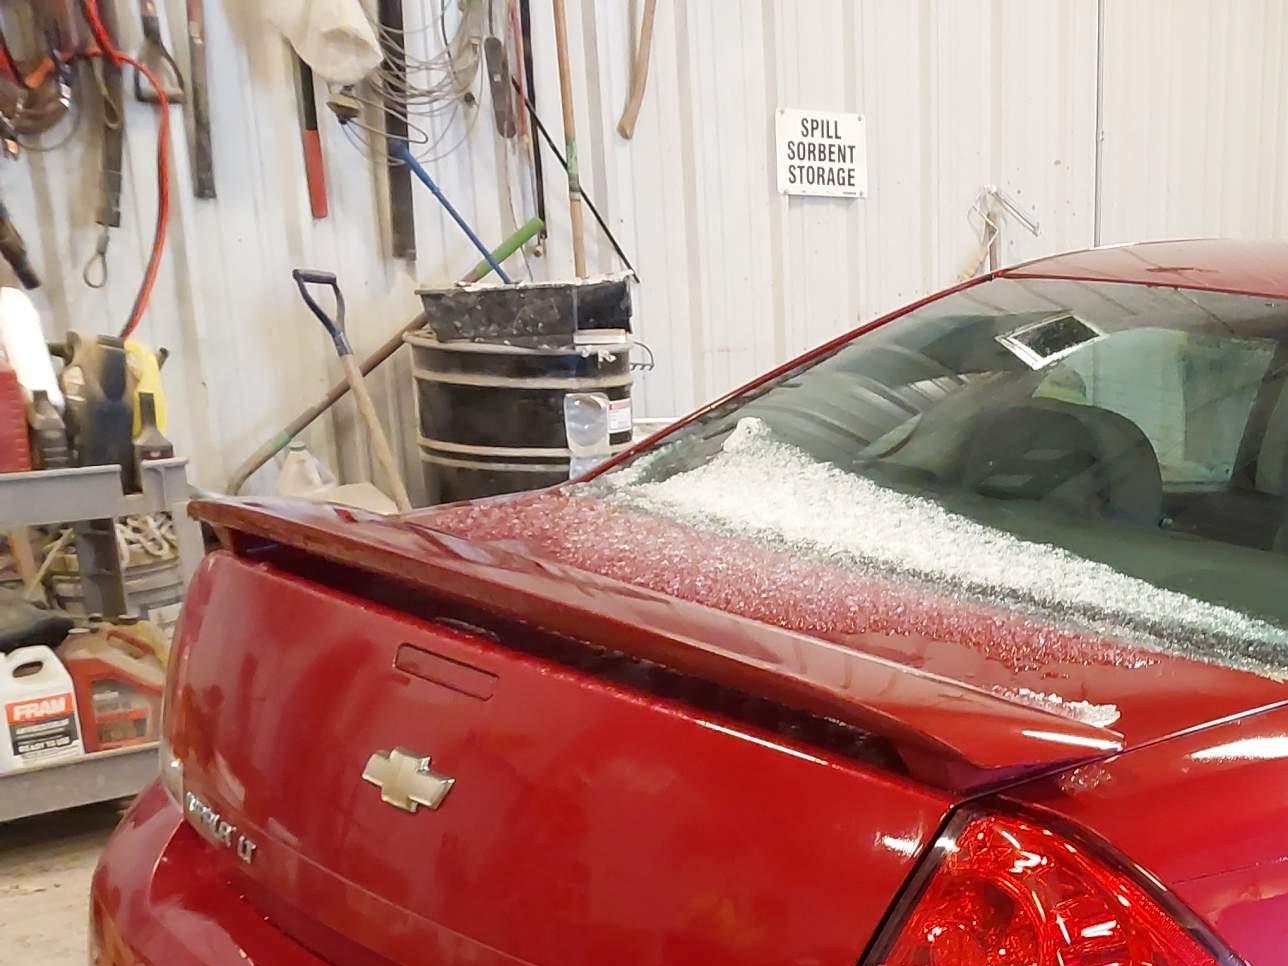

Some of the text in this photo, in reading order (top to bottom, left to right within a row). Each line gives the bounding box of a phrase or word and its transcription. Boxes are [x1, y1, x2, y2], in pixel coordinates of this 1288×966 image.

[801, 117, 842, 140] SPILL
[787, 140, 856, 164] SORBENT
[788, 164, 856, 187] STORAGE
[13, 696, 66, 721] FRAM
